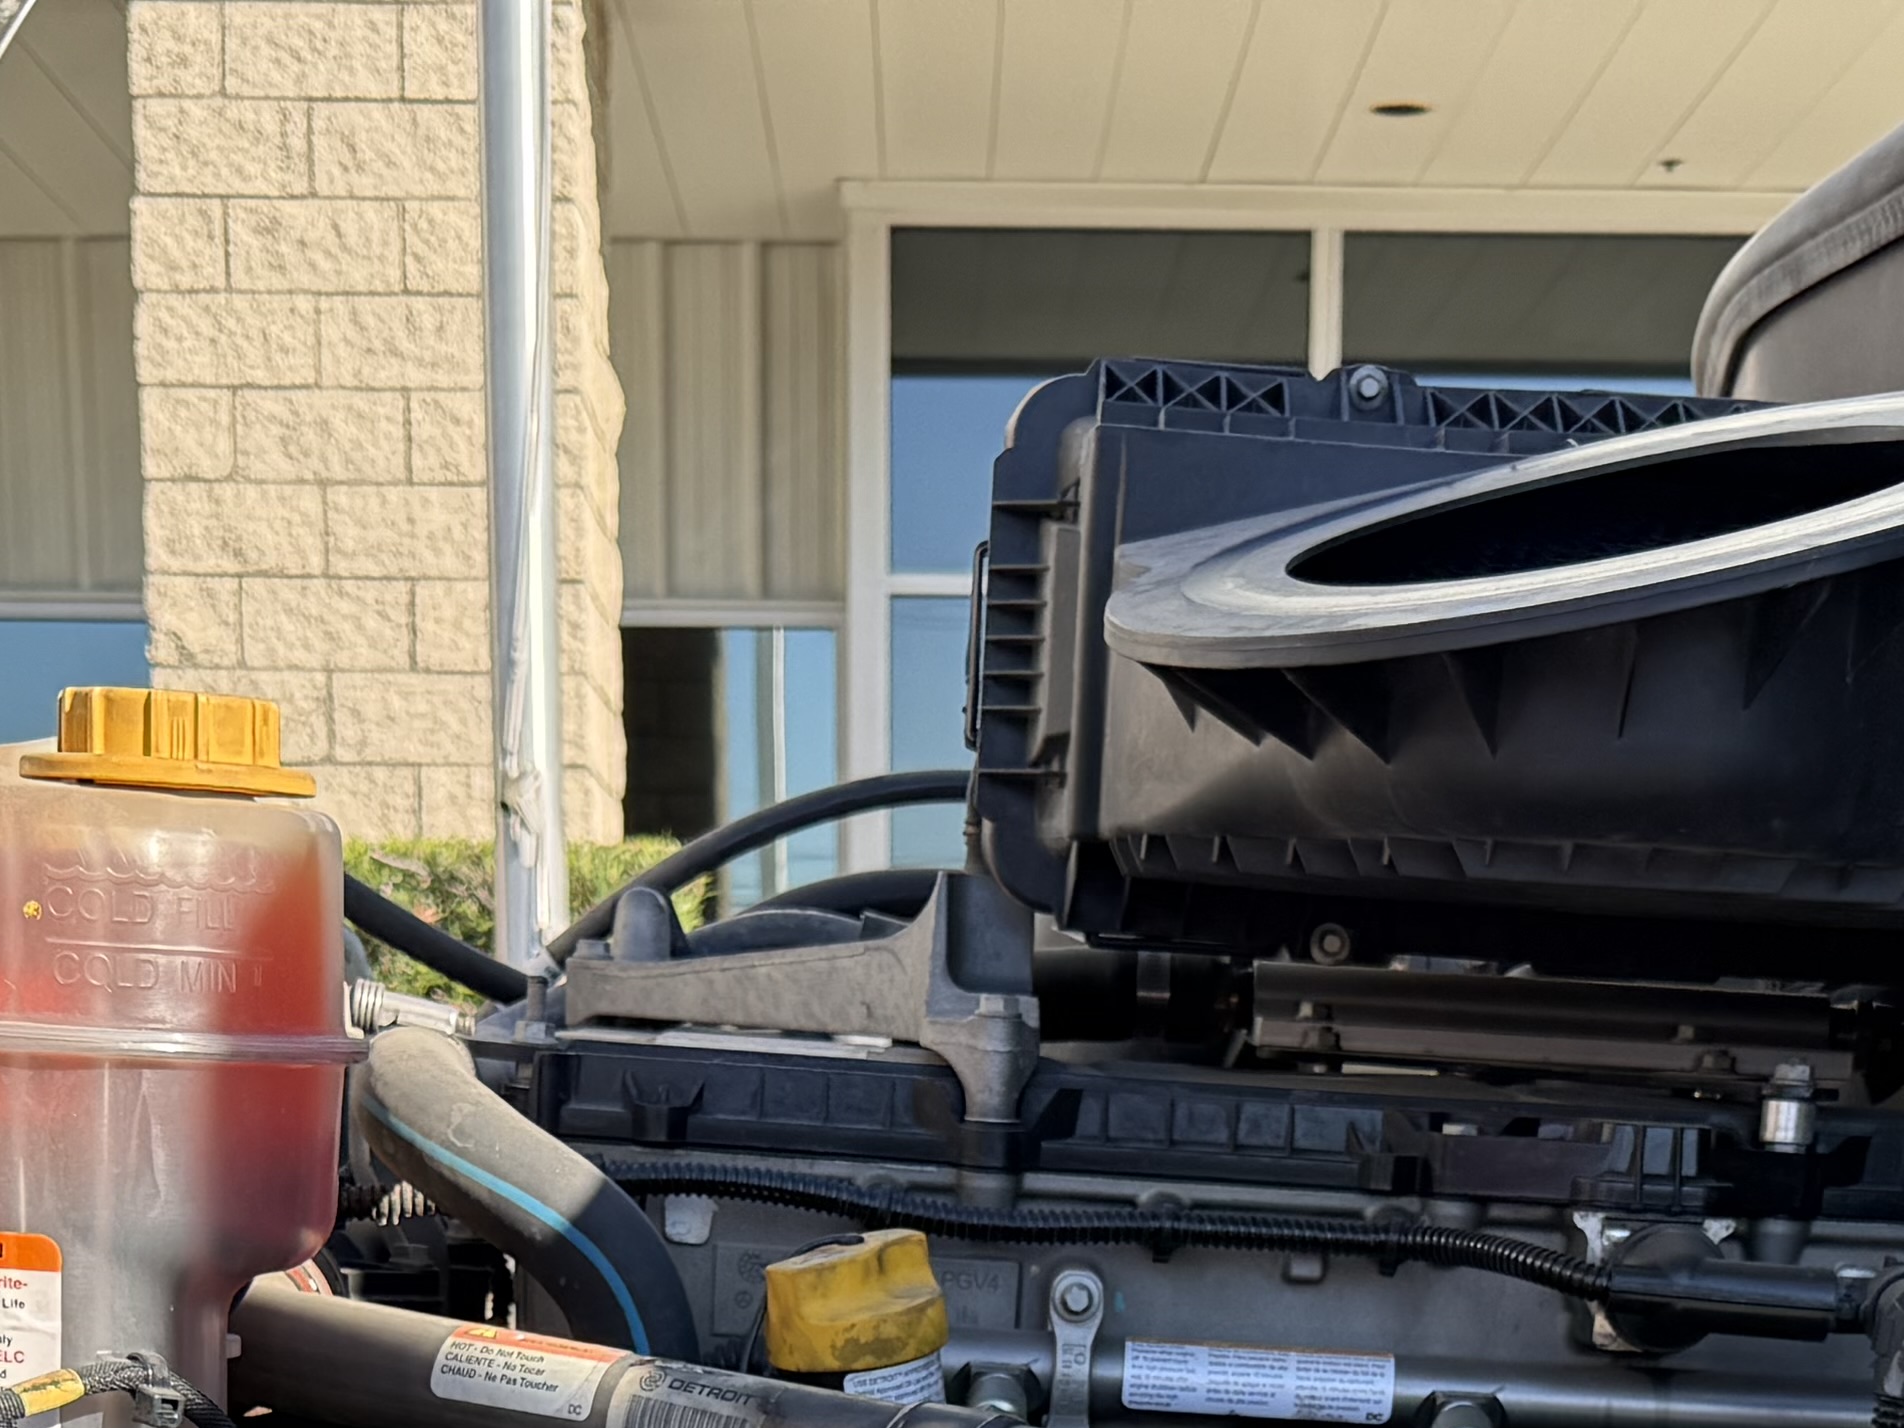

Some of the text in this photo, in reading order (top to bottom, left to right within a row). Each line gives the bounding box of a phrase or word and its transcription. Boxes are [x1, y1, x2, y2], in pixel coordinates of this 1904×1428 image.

[47, 886, 236, 930] COLD FILL
[180, 960, 236, 992] MIN
[3, 1299, 25, 1309] Life
[450, 1340, 545, 1363] HOT Do Not Touch
[446, 1352, 545, 1377] CALIENTE No Tocar
[441, 1364, 559, 1392] CHAUD Ne Pas Toucher
[668, 1377, 759, 1406] DETROIT
[568, 1404, 582, 1416] DC
[1366, 1412, 1383, 1421] DC
